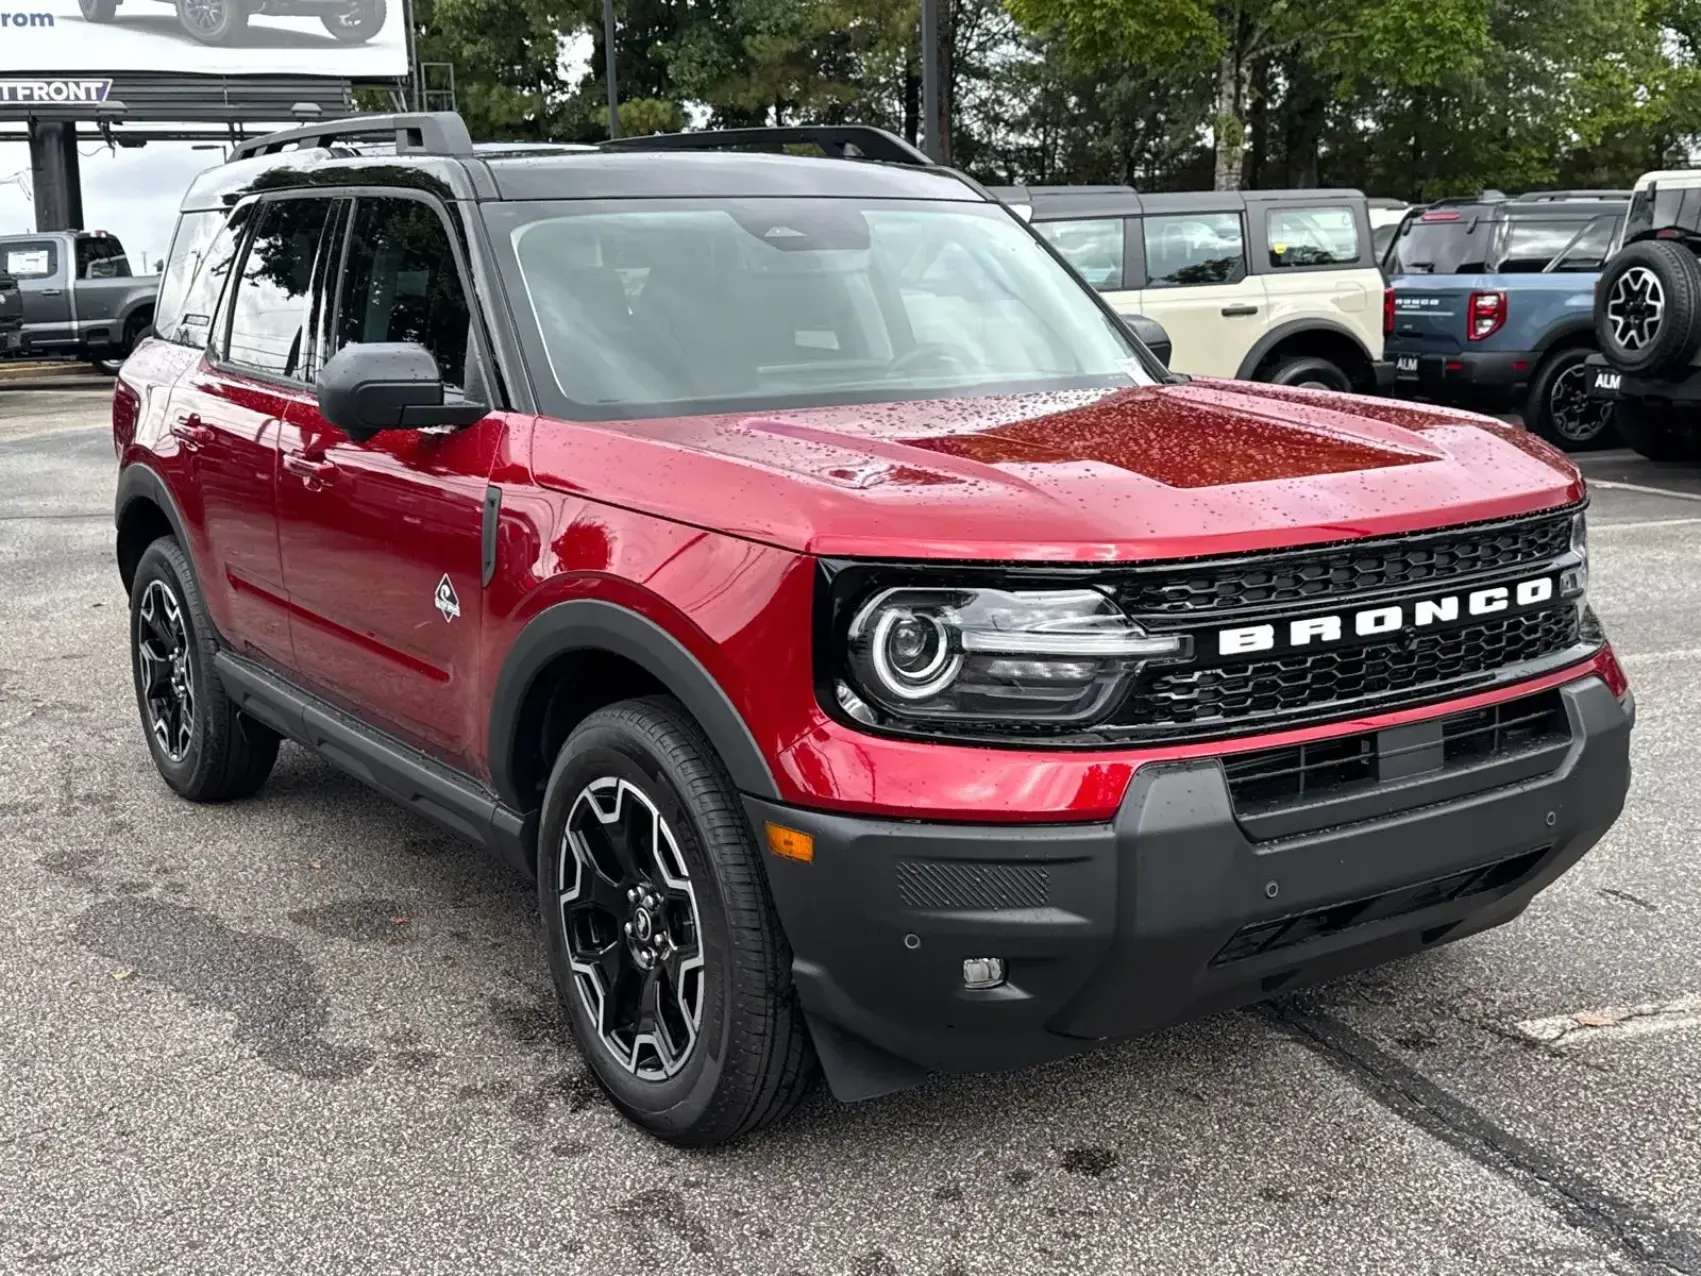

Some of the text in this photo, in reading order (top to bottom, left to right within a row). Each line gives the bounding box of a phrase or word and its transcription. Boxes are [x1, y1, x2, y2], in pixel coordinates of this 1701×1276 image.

[1, 13, 55, 27] rom
[1396, 358, 1418, 371] ALM
[1595, 373, 1621, 389] ALM
[1218, 577, 1553, 656] BRONCO
